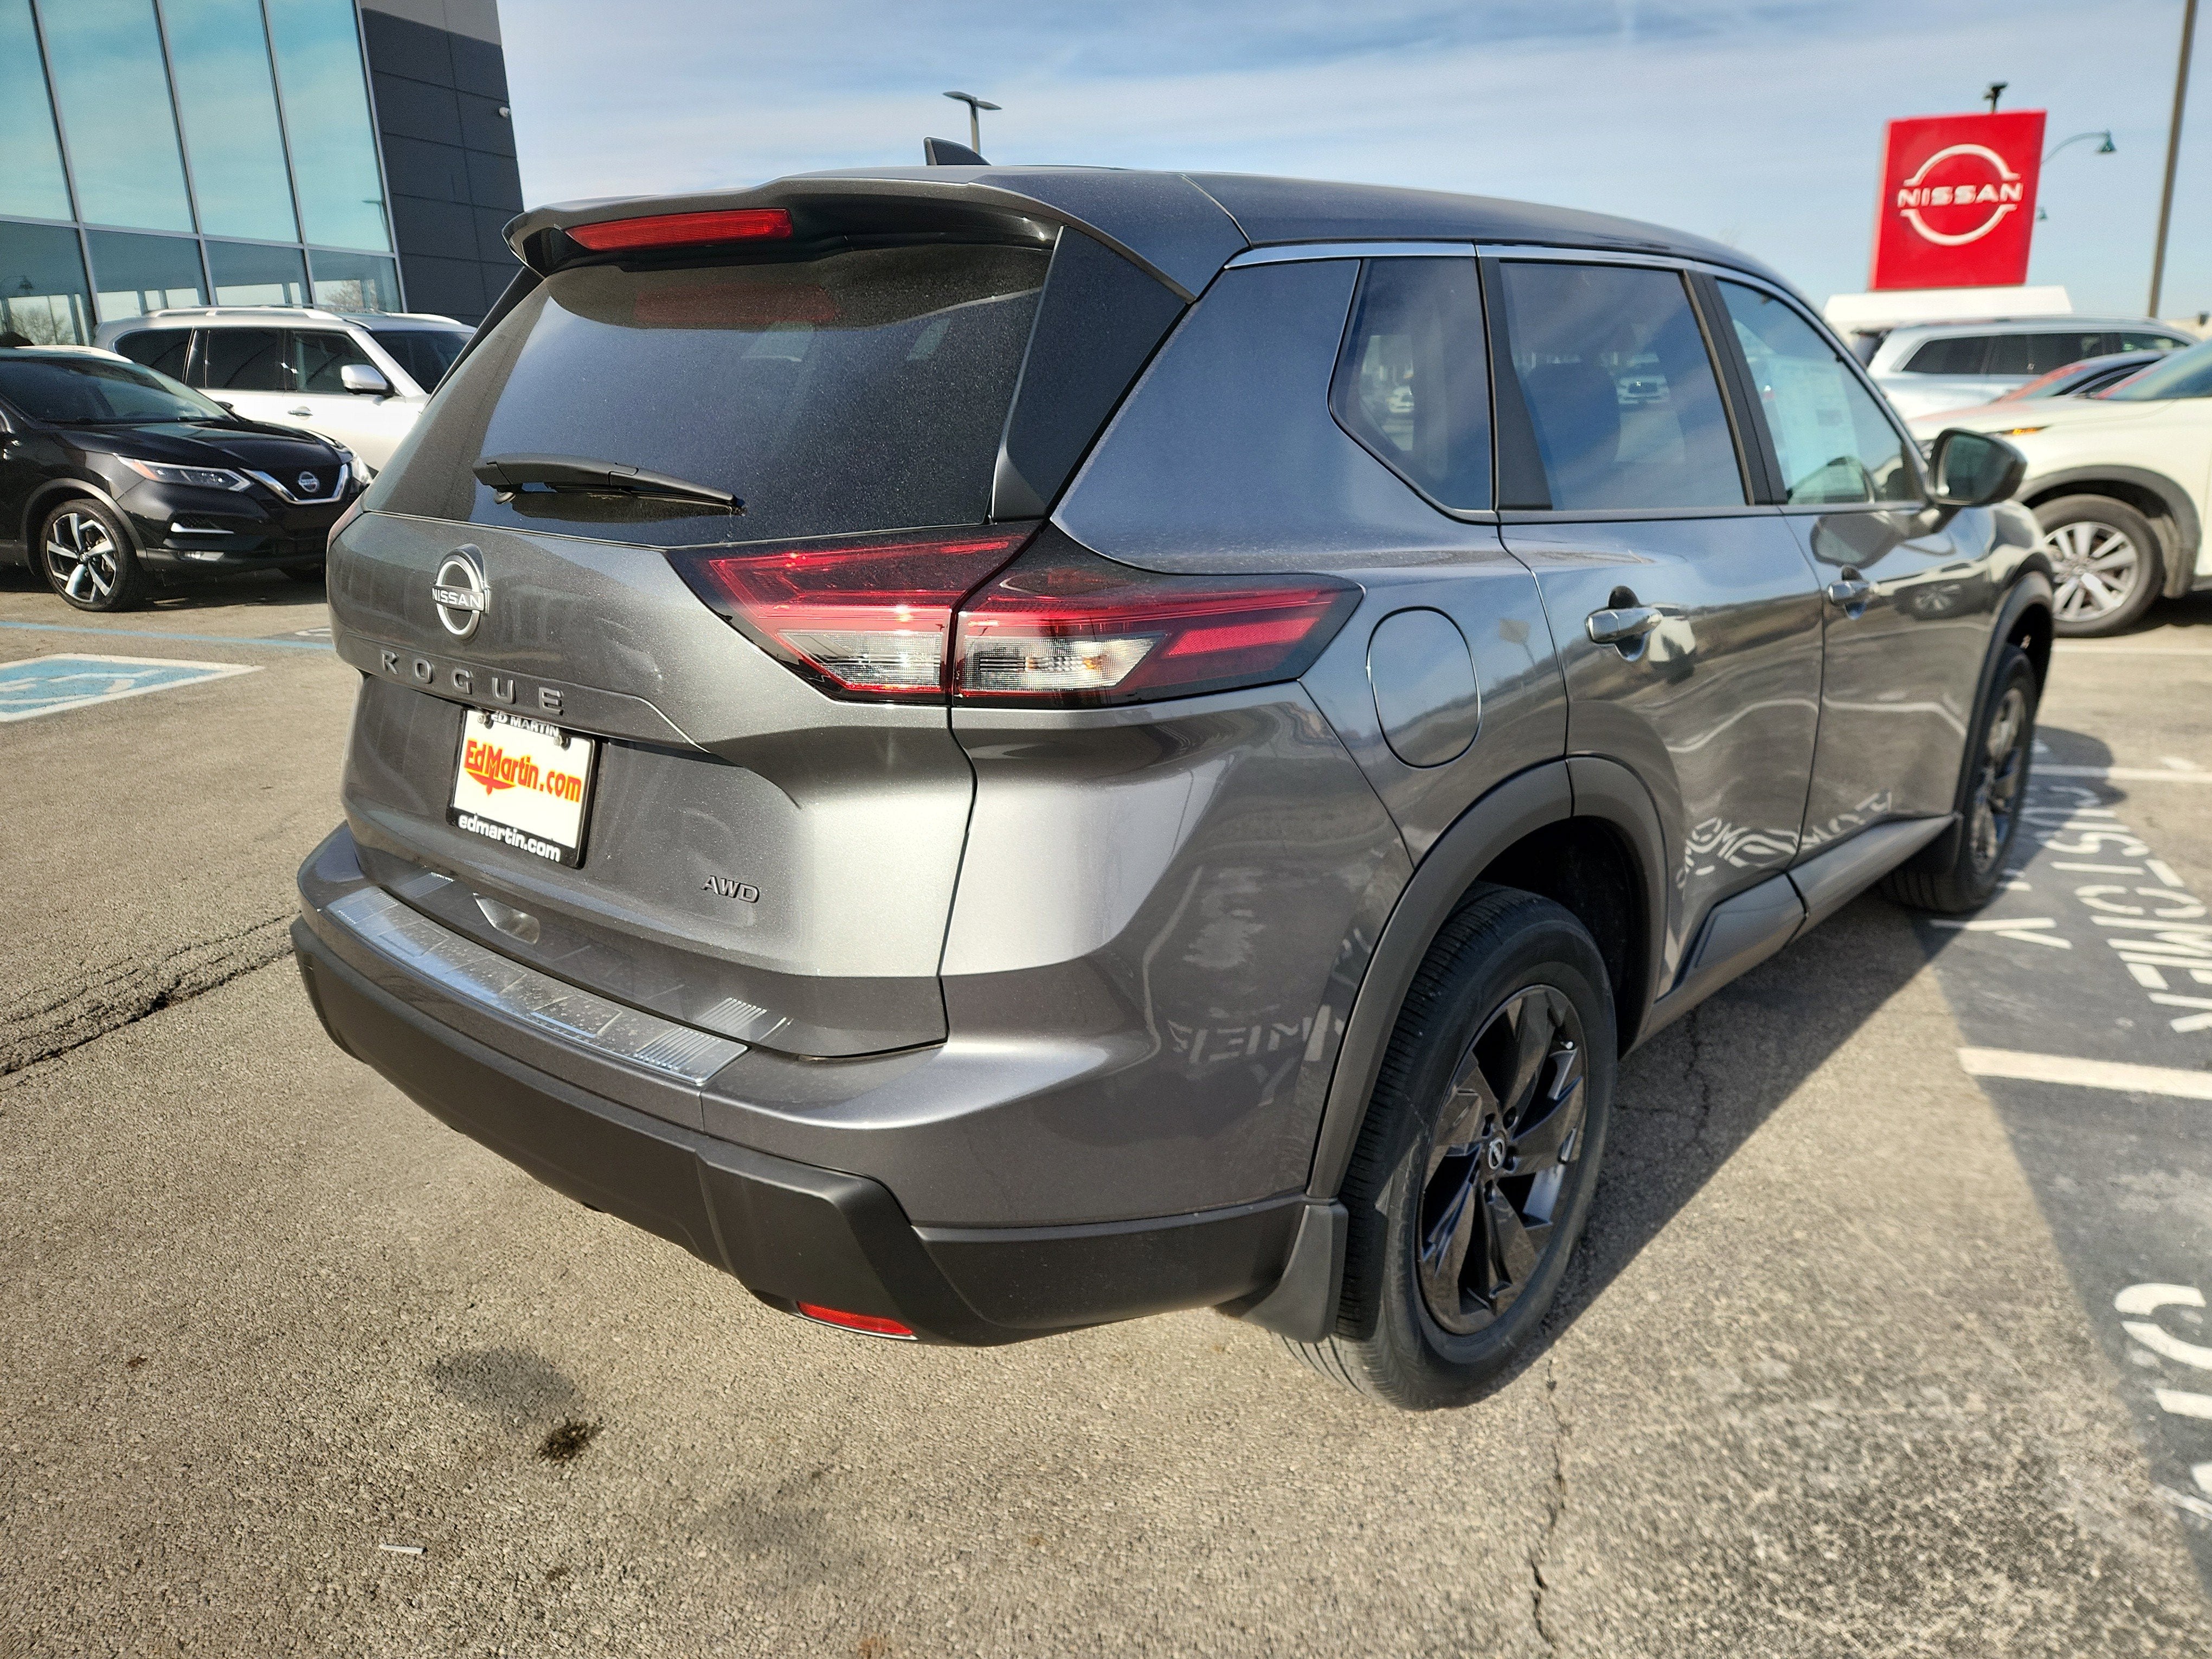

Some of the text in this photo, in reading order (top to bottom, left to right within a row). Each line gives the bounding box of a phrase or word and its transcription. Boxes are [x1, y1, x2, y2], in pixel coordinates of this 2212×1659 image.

[1898, 183, 2023, 208] NISSAN
[432, 588, 481, 608] NISSAN
[381, 651, 564, 716] ROGUE
[510, 716, 560, 737] MARTIN
[464, 738, 582, 803] EdMartin.com
[458, 813, 561, 862] edmartin.com
[702, 875, 760, 904] AWD
